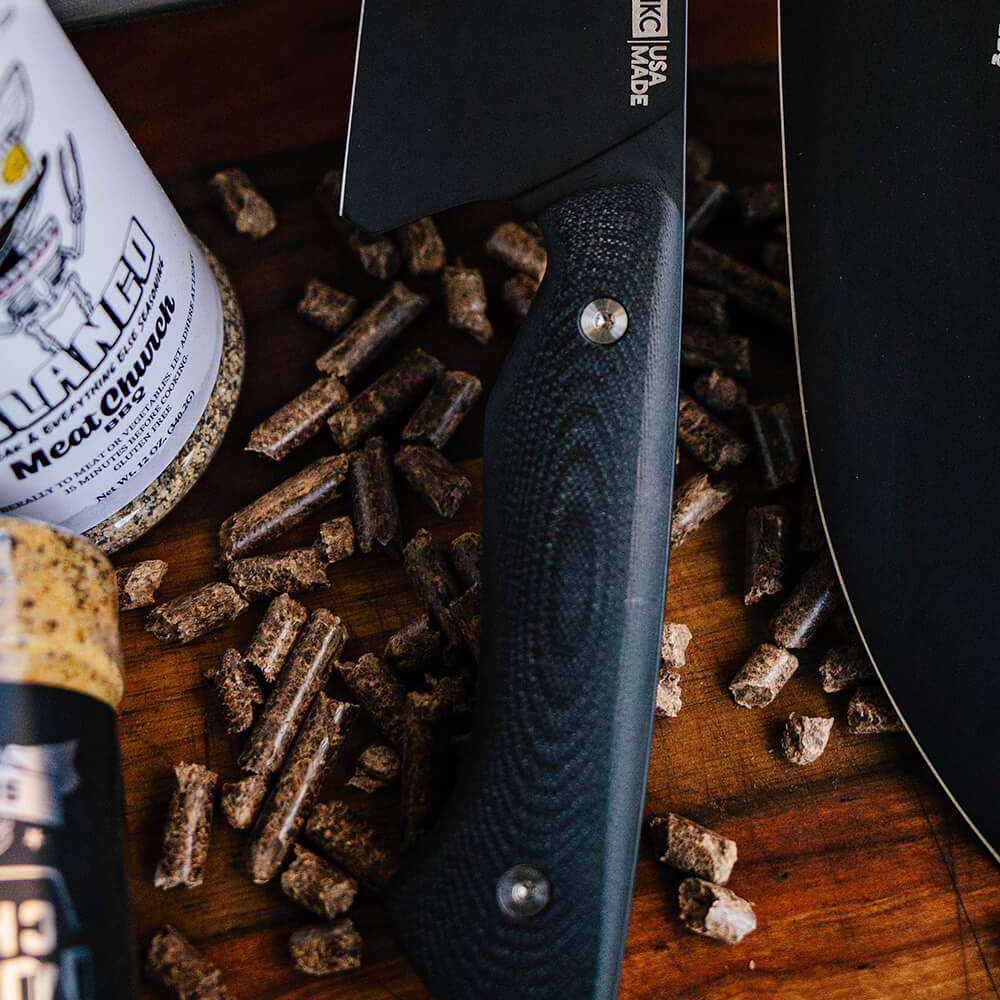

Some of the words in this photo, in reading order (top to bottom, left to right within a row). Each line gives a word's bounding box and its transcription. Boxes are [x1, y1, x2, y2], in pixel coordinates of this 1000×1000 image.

[630, 45, 649, 107] MADE
[648, 45, 668, 87] USA
[0, 216, 155, 442] LANCO
[116, 330, 138, 364] ELSE
[10, 412, 102, 481] Meat
[100, 295, 175, 417] Church
[57, 475, 74, 489] TO
[74, 451, 106, 478] MEAT
[106, 437, 123, 453] OR
[169, 346, 184, 371] LET
[180, 304, 196, 349] ADHERE
[65, 485, 78, 496] 15
[78, 445, 129, 487] MINUTES
[127, 406, 164, 447] BEFORE
[160, 353, 190, 407] COOKING.
[104, 386, 146, 434] BBQ
[96, 485, 118, 503] Net
[137, 456, 150, 470] 12
[166, 388, 196, 436] (340.2G)
[112, 433, 152, 473] GLUTEN
[151, 404, 174, 434] FREE
